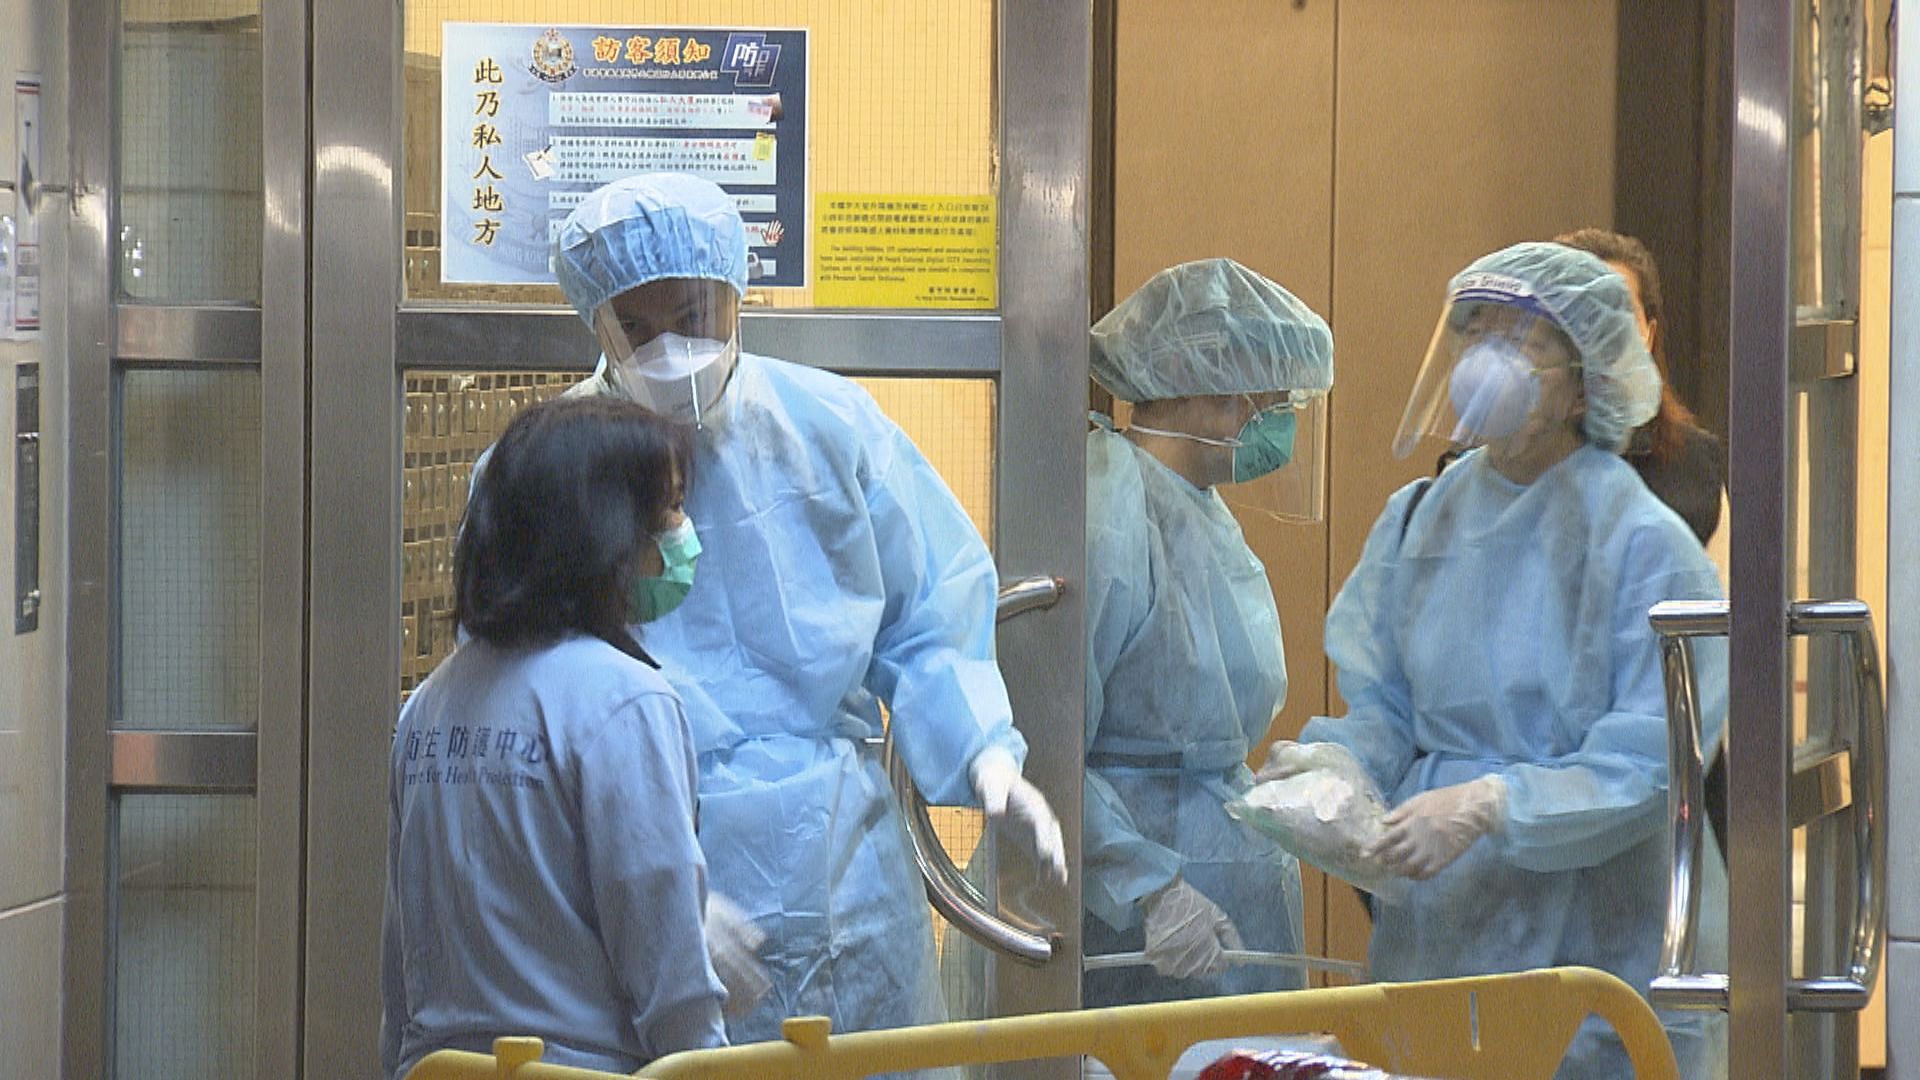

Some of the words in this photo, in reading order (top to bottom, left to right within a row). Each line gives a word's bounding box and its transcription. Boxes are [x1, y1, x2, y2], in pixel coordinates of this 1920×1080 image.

[592, 36, 711, 64] 訪客須知
[473, 57, 503, 246] 此乃私人地方
